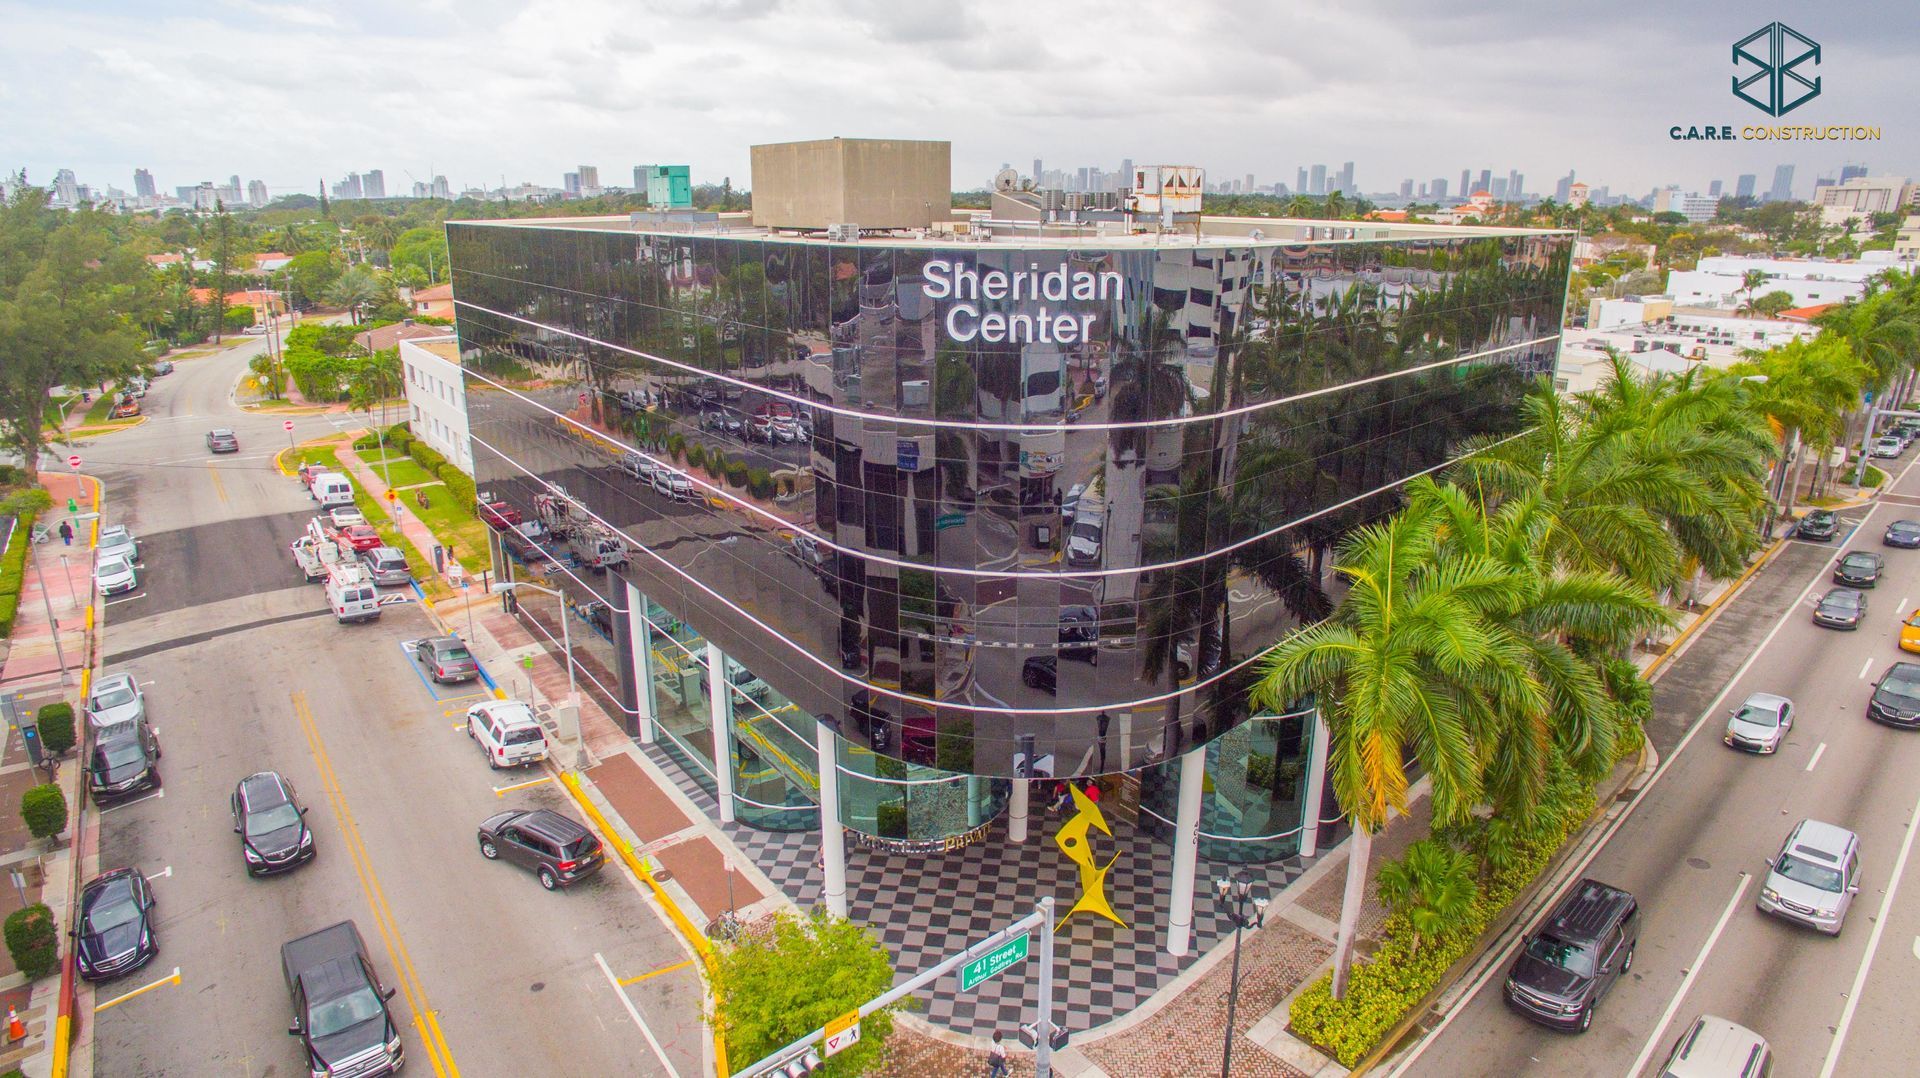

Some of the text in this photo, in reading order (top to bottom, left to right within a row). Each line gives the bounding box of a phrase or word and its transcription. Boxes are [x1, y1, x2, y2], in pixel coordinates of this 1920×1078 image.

[922, 260, 1124, 302] Sheridan
[946, 304, 1097, 344] Center
[968, 951, 1023, 987] Arthur Godfrey Rd
[973, 944, 1017, 975] 41 Street
